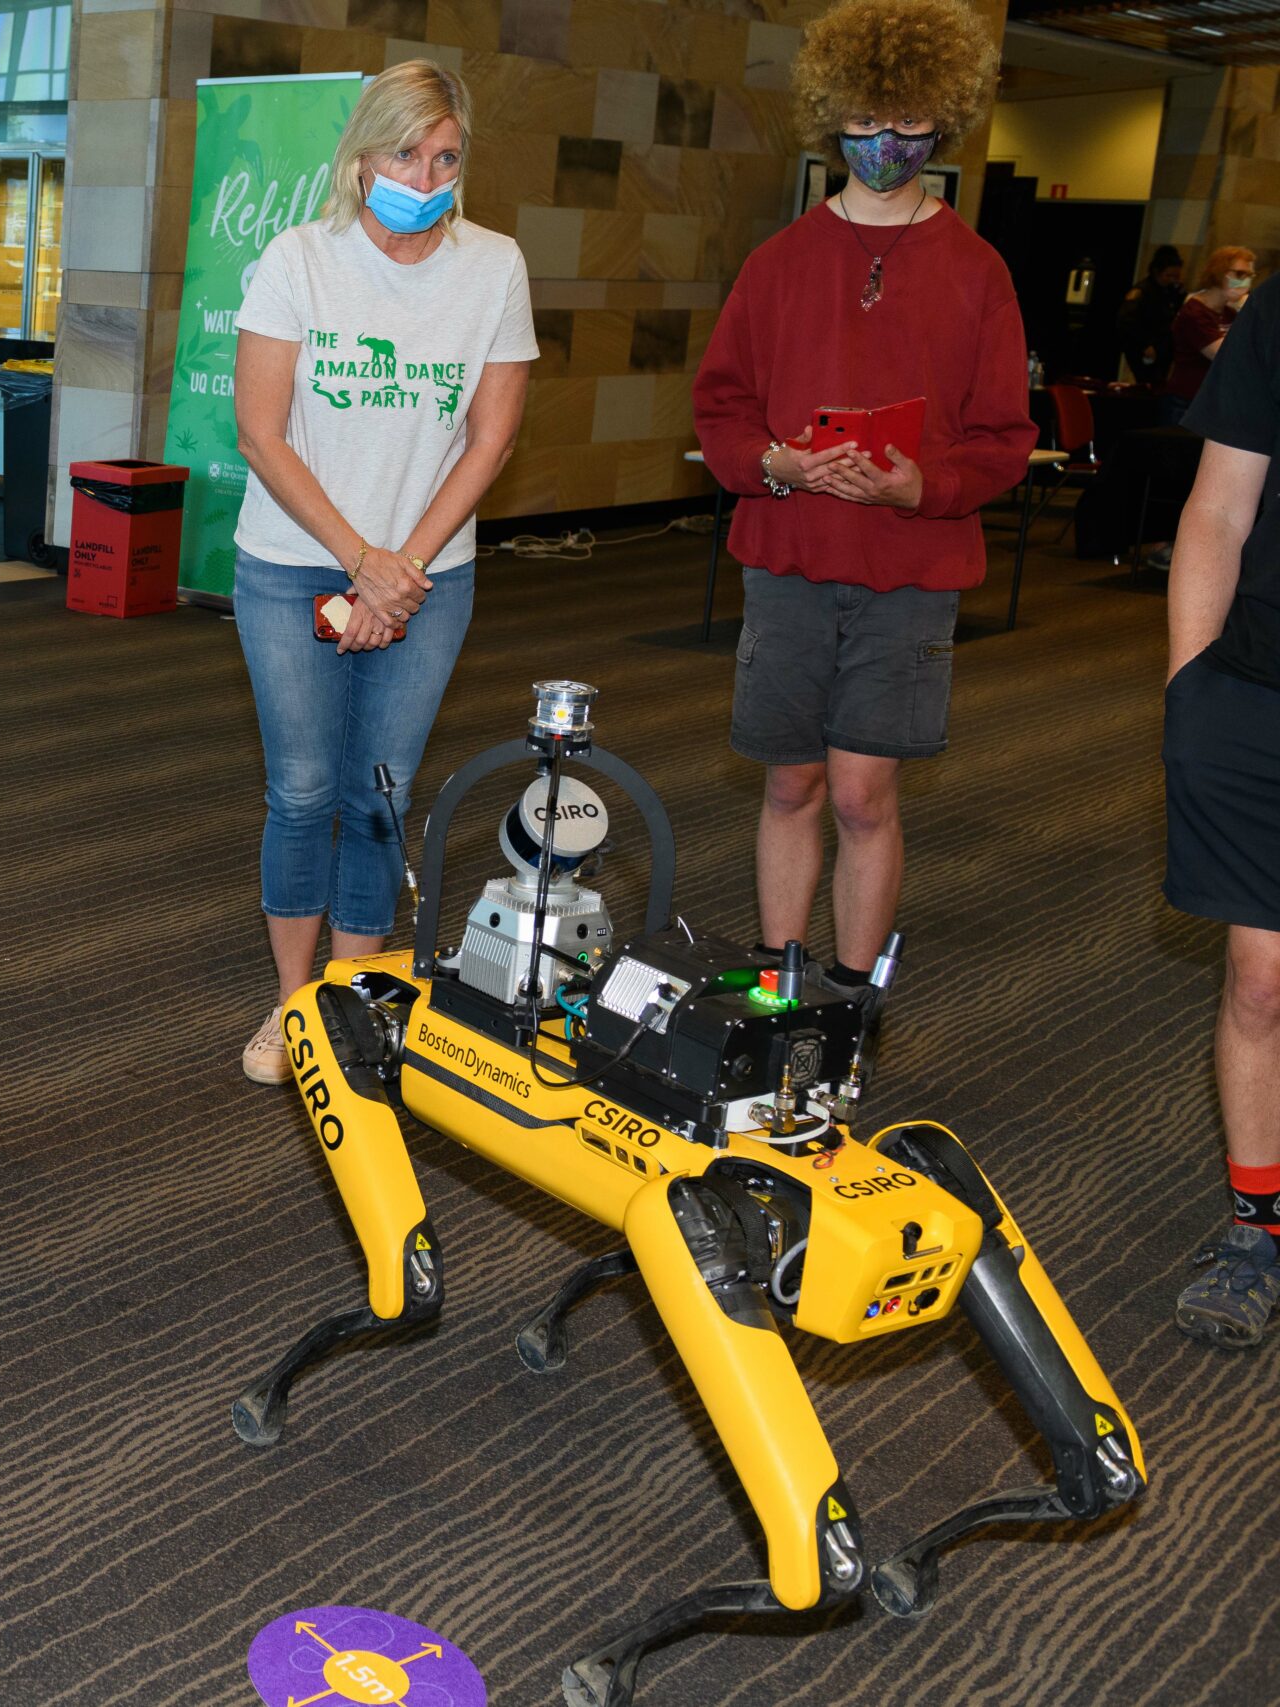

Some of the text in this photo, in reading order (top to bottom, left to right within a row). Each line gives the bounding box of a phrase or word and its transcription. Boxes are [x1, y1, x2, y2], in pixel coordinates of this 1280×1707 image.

[210, 163, 330, 250] Refill
[308, 329, 339, 349] THE
[314, 359, 466, 380] AMAZON DANCE
[190, 372, 208, 394] UQ
[361, 390, 421, 409] PARTY
[74, 550, 97, 561] ONLY
[75, 540, 115, 555] LANDFILL
[284, 1009, 344, 1151] CSIRO
[584, 1100, 661, 1148] CSIRO
[834, 1172, 917, 1199] CSIRO
[335, 1653, 394, 1702] 1.5m
